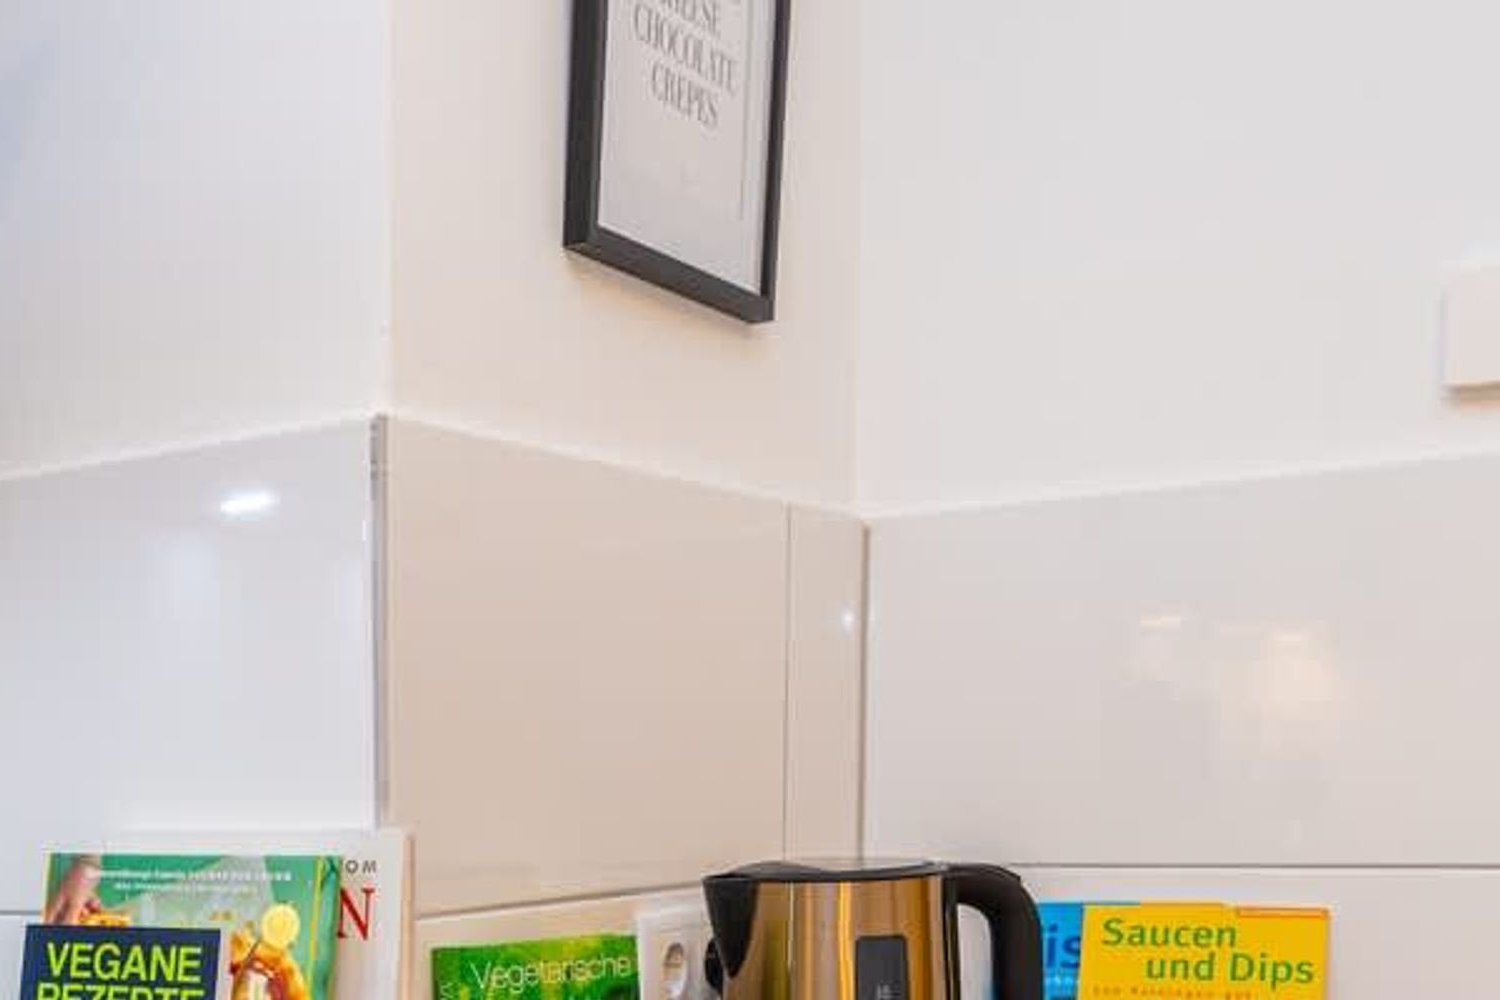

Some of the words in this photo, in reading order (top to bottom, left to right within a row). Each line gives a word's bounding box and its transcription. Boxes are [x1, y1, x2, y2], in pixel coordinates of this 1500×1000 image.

[1101, 918, 1238, 948] Saucen
[47, 942, 202, 983] VEGANE
[470, 954, 631, 994] Vegetarische
[1146, 952, 1217, 981] und
[1229, 952, 1315, 991] Dips
